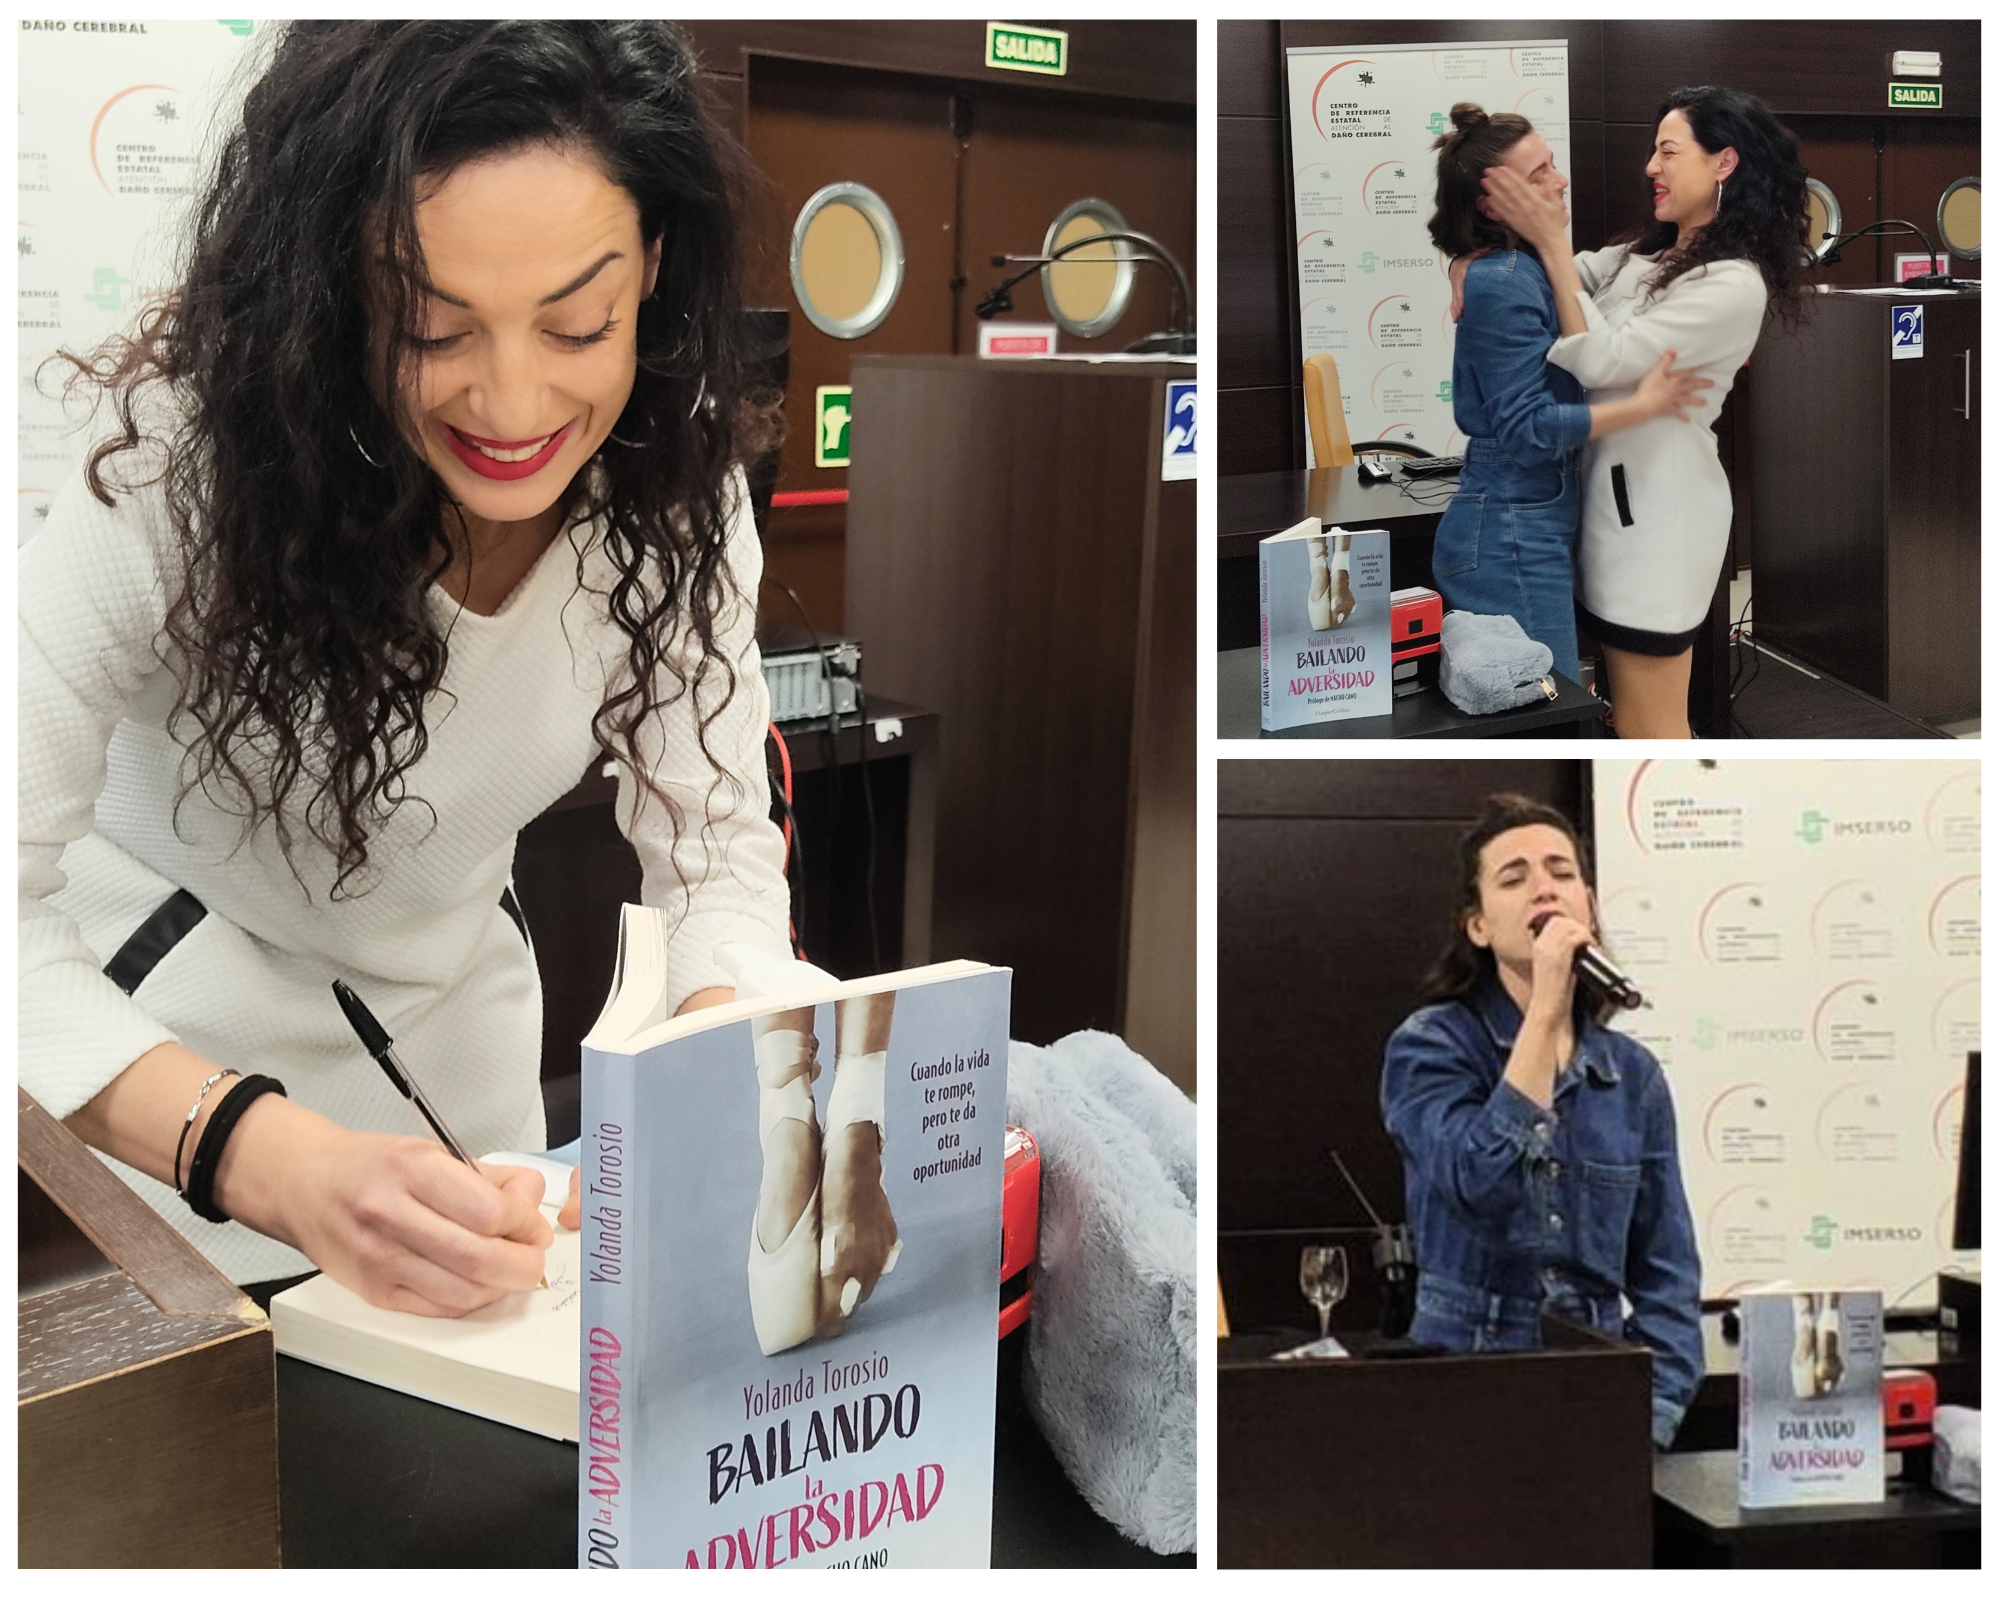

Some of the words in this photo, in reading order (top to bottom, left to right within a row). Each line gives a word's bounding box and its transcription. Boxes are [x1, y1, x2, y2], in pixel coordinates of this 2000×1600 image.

[22, 20, 66, 31] DAÑO
[73, 21, 148, 34] CEREBRAL
[995, 33, 1058, 64] SALIDA
[1894, 88, 1936, 103] SALIDA
[117, 165, 160, 173] ESTATAL
[1383, 258, 1434, 268] IMSERSO
[1307, 636, 1331, 648] Yolanda
[1332, 635, 1355, 645] Torosio
[1296, 645, 1366, 669] BAILANDO
[1287, 670, 1375, 696] ADVERSIDAD
[1307, 697, 1324, 705] Prólogo
[1315, 708, 1350, 716] HarperCollins
[1834, 819, 1911, 836] IMSERSO
[1727, 1028, 1804, 1042] IMSERSO
[911, 1056, 952, 1082] Cuando
[955, 1054, 964, 1074] la
[967, 1048, 990, 1071] vida
[925, 1088, 935, 1104] te
[938, 1081, 975, 1102] rompe,
[922, 1112, 947, 1134] pero
[950, 1107, 960, 1123] te
[963, 1101, 976, 1121] da
[938, 1133, 960, 1151] otra
[590, 1122, 623, 1197] Torosio
[913, 1146, 982, 1184] oportunidad
[589, 1206, 622, 1285] Yolanda
[1844, 1227, 1922, 1242] IMSERSO
[743, 1368, 814, 1421] Yolanda
[821, 1350, 889, 1394] Torosio
[588, 1326, 622, 1507] ADVERSIDAD
[706, 1383, 921, 1506] BAILANDO
[805, 1474, 826, 1500] la
[592, 1508, 612, 1526] la
